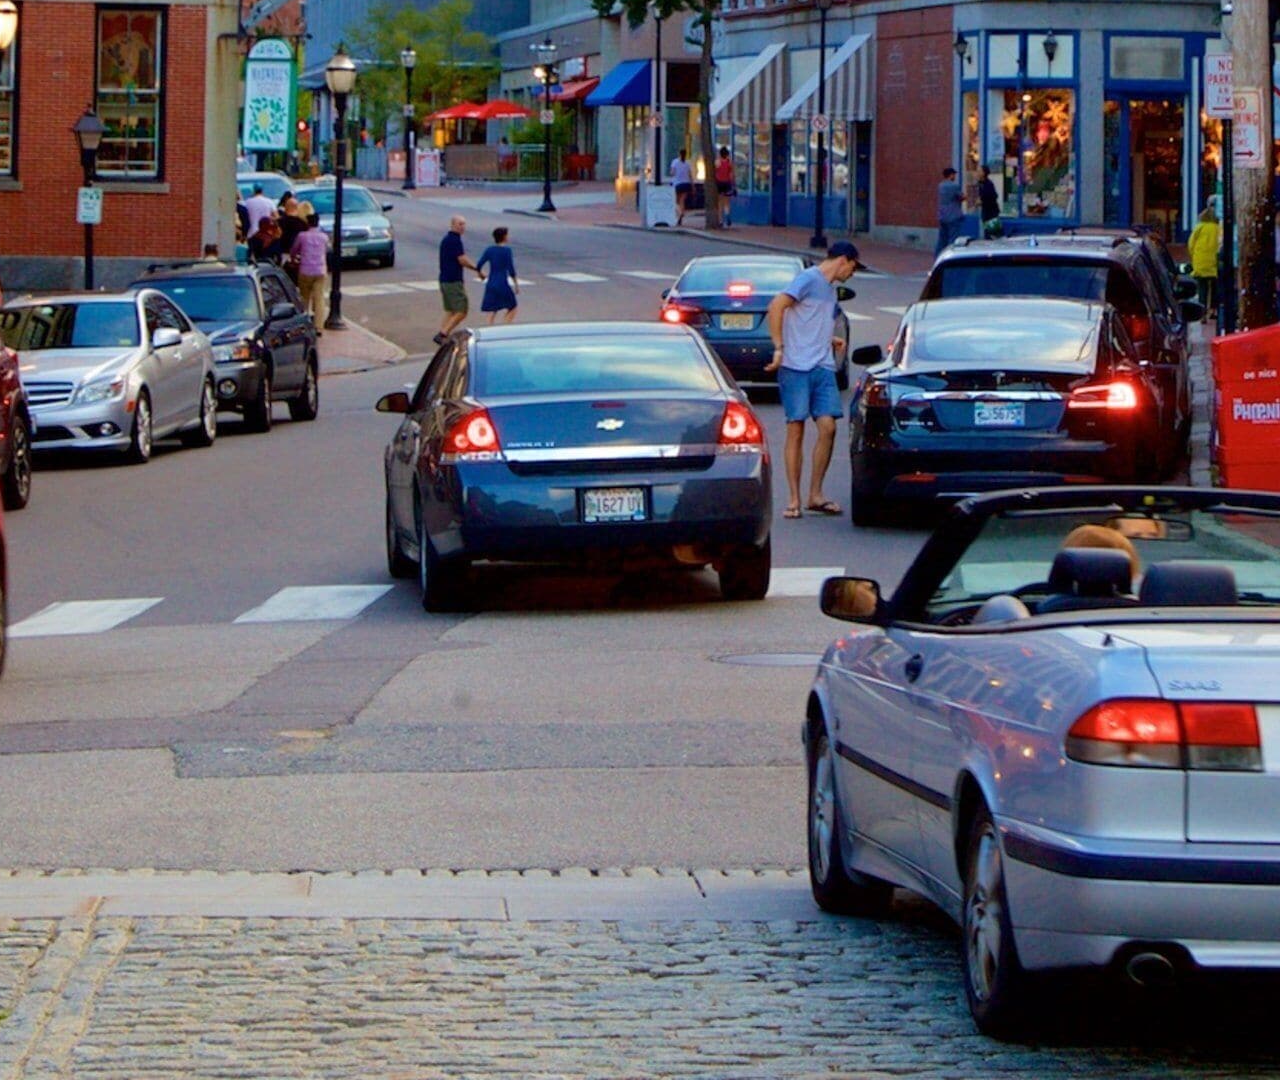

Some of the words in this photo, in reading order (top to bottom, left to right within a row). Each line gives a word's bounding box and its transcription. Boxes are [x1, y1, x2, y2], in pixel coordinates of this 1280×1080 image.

[1206, 74, 1233, 85] PARK
[1258, 369, 1278, 378] nice
[596, 496, 624, 514] 1627
